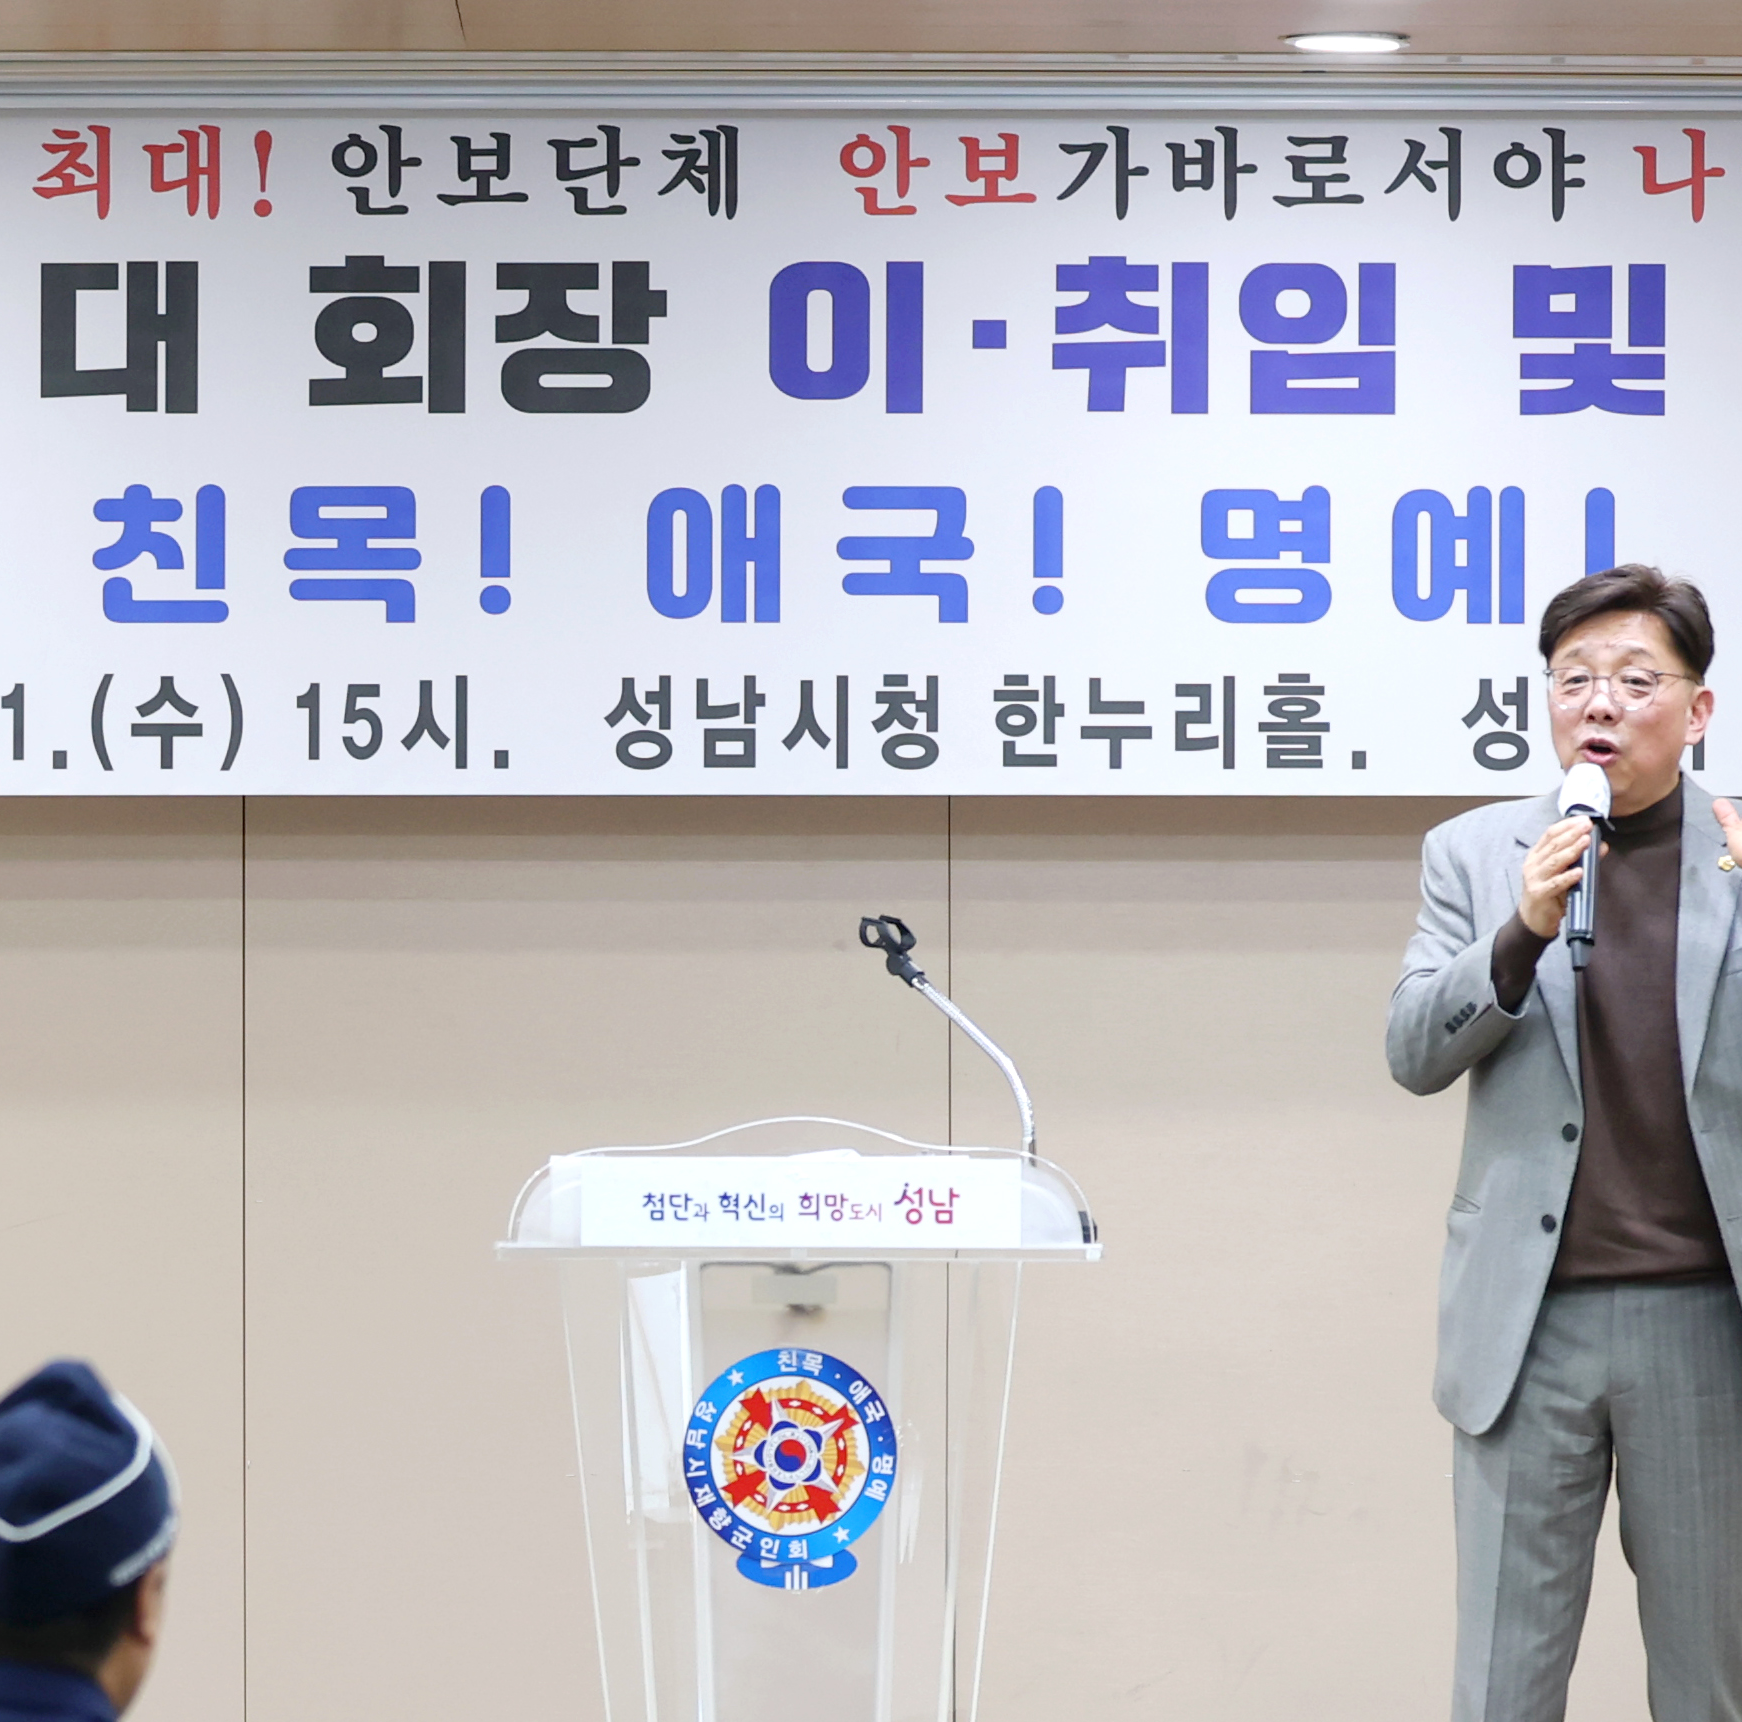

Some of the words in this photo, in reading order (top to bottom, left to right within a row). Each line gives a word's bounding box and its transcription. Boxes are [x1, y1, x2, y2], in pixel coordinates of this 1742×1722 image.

[33, 124, 274, 222] 최대!
[332, 124, 741, 222] 안보단체
[309, 255, 669, 417] 회장
[769, 256, 1398, 417] 이·취임
[1512, 264, 1668, 419] 및
[92, 484, 513, 625] 친목!
[647, 484, 1066, 625] 애국!
[297, 675, 511, 771] 15시.
[604, 675, 941, 772] 성남시청
[994, 674, 1368, 771] 한누리홀.
[642, 1192, 710, 1222] 첨단과
[718, 1191, 784, 1223] 혁신의
[798, 1192, 883, 1222] 희망도시
[894, 1182, 961, 1226] 성남
[777, 1351, 824, 1377] 친목
[848, 1380, 886, 1424] 애국
[864, 1453, 894, 1502] 명예
